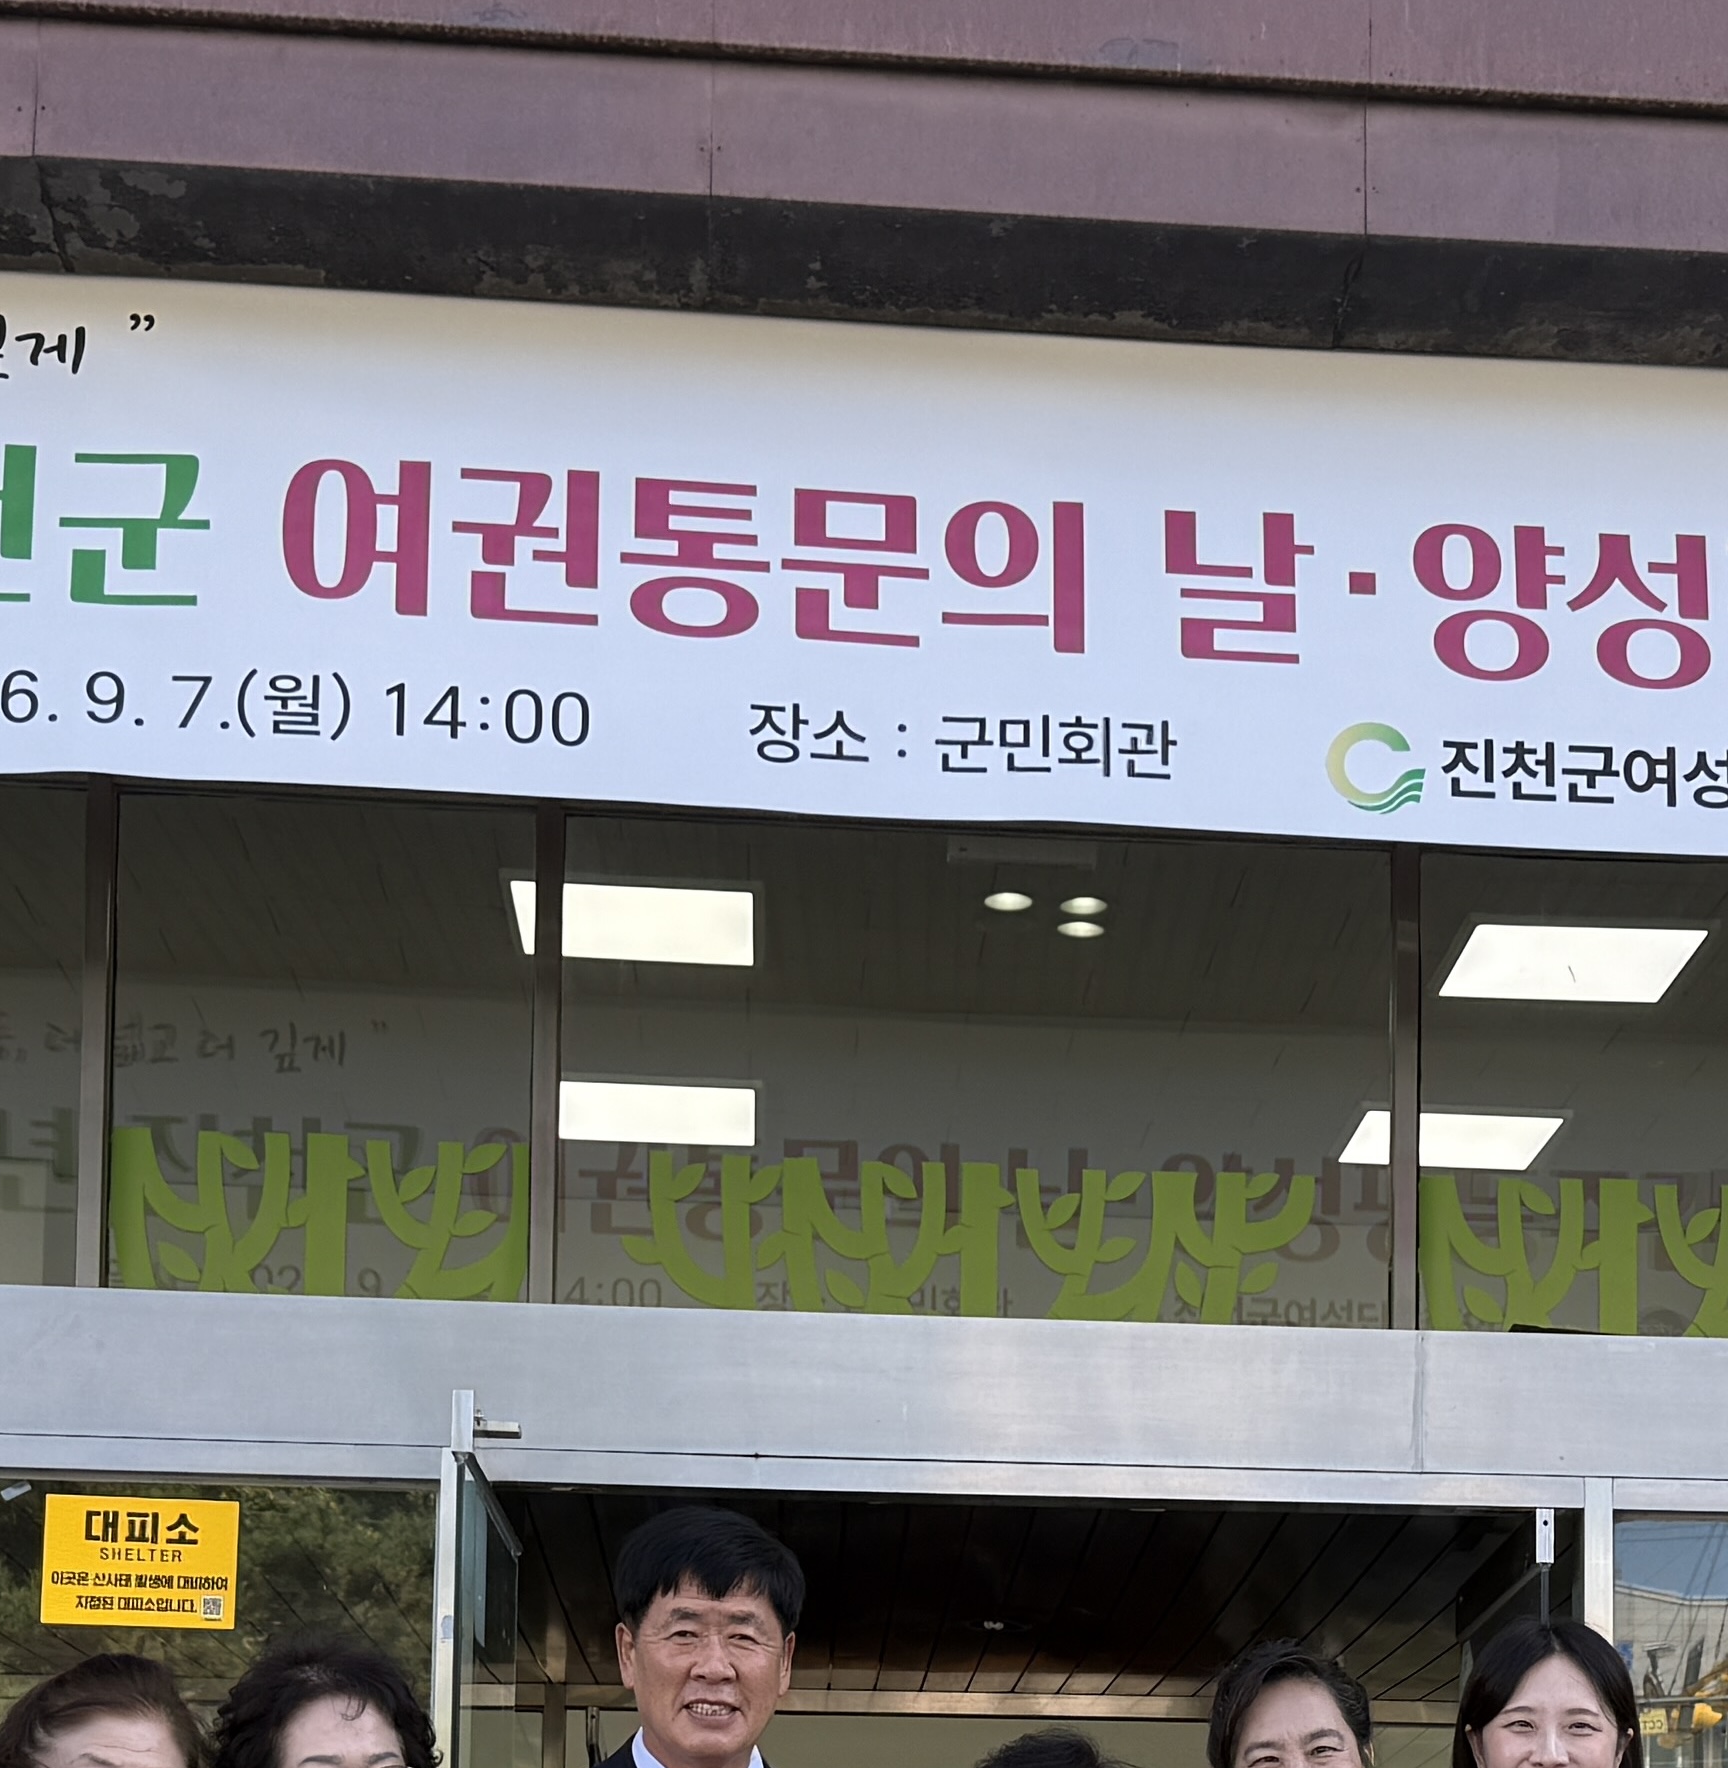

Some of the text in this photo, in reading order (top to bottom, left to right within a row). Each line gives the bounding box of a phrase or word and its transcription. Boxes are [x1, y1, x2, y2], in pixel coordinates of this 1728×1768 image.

[282, 458, 1086, 655] 여권통문의
[85, 670, 145, 727] 9.
[171, 667, 351, 742] 7.(월)
[385, 682, 590, 748] 14:00
[748, 702, 870, 764] 장소
[934, 713, 1179, 781] 군민회관
[84, 1509, 200, 1546] 대피소
[99, 1547, 183, 1562] SHELTER
